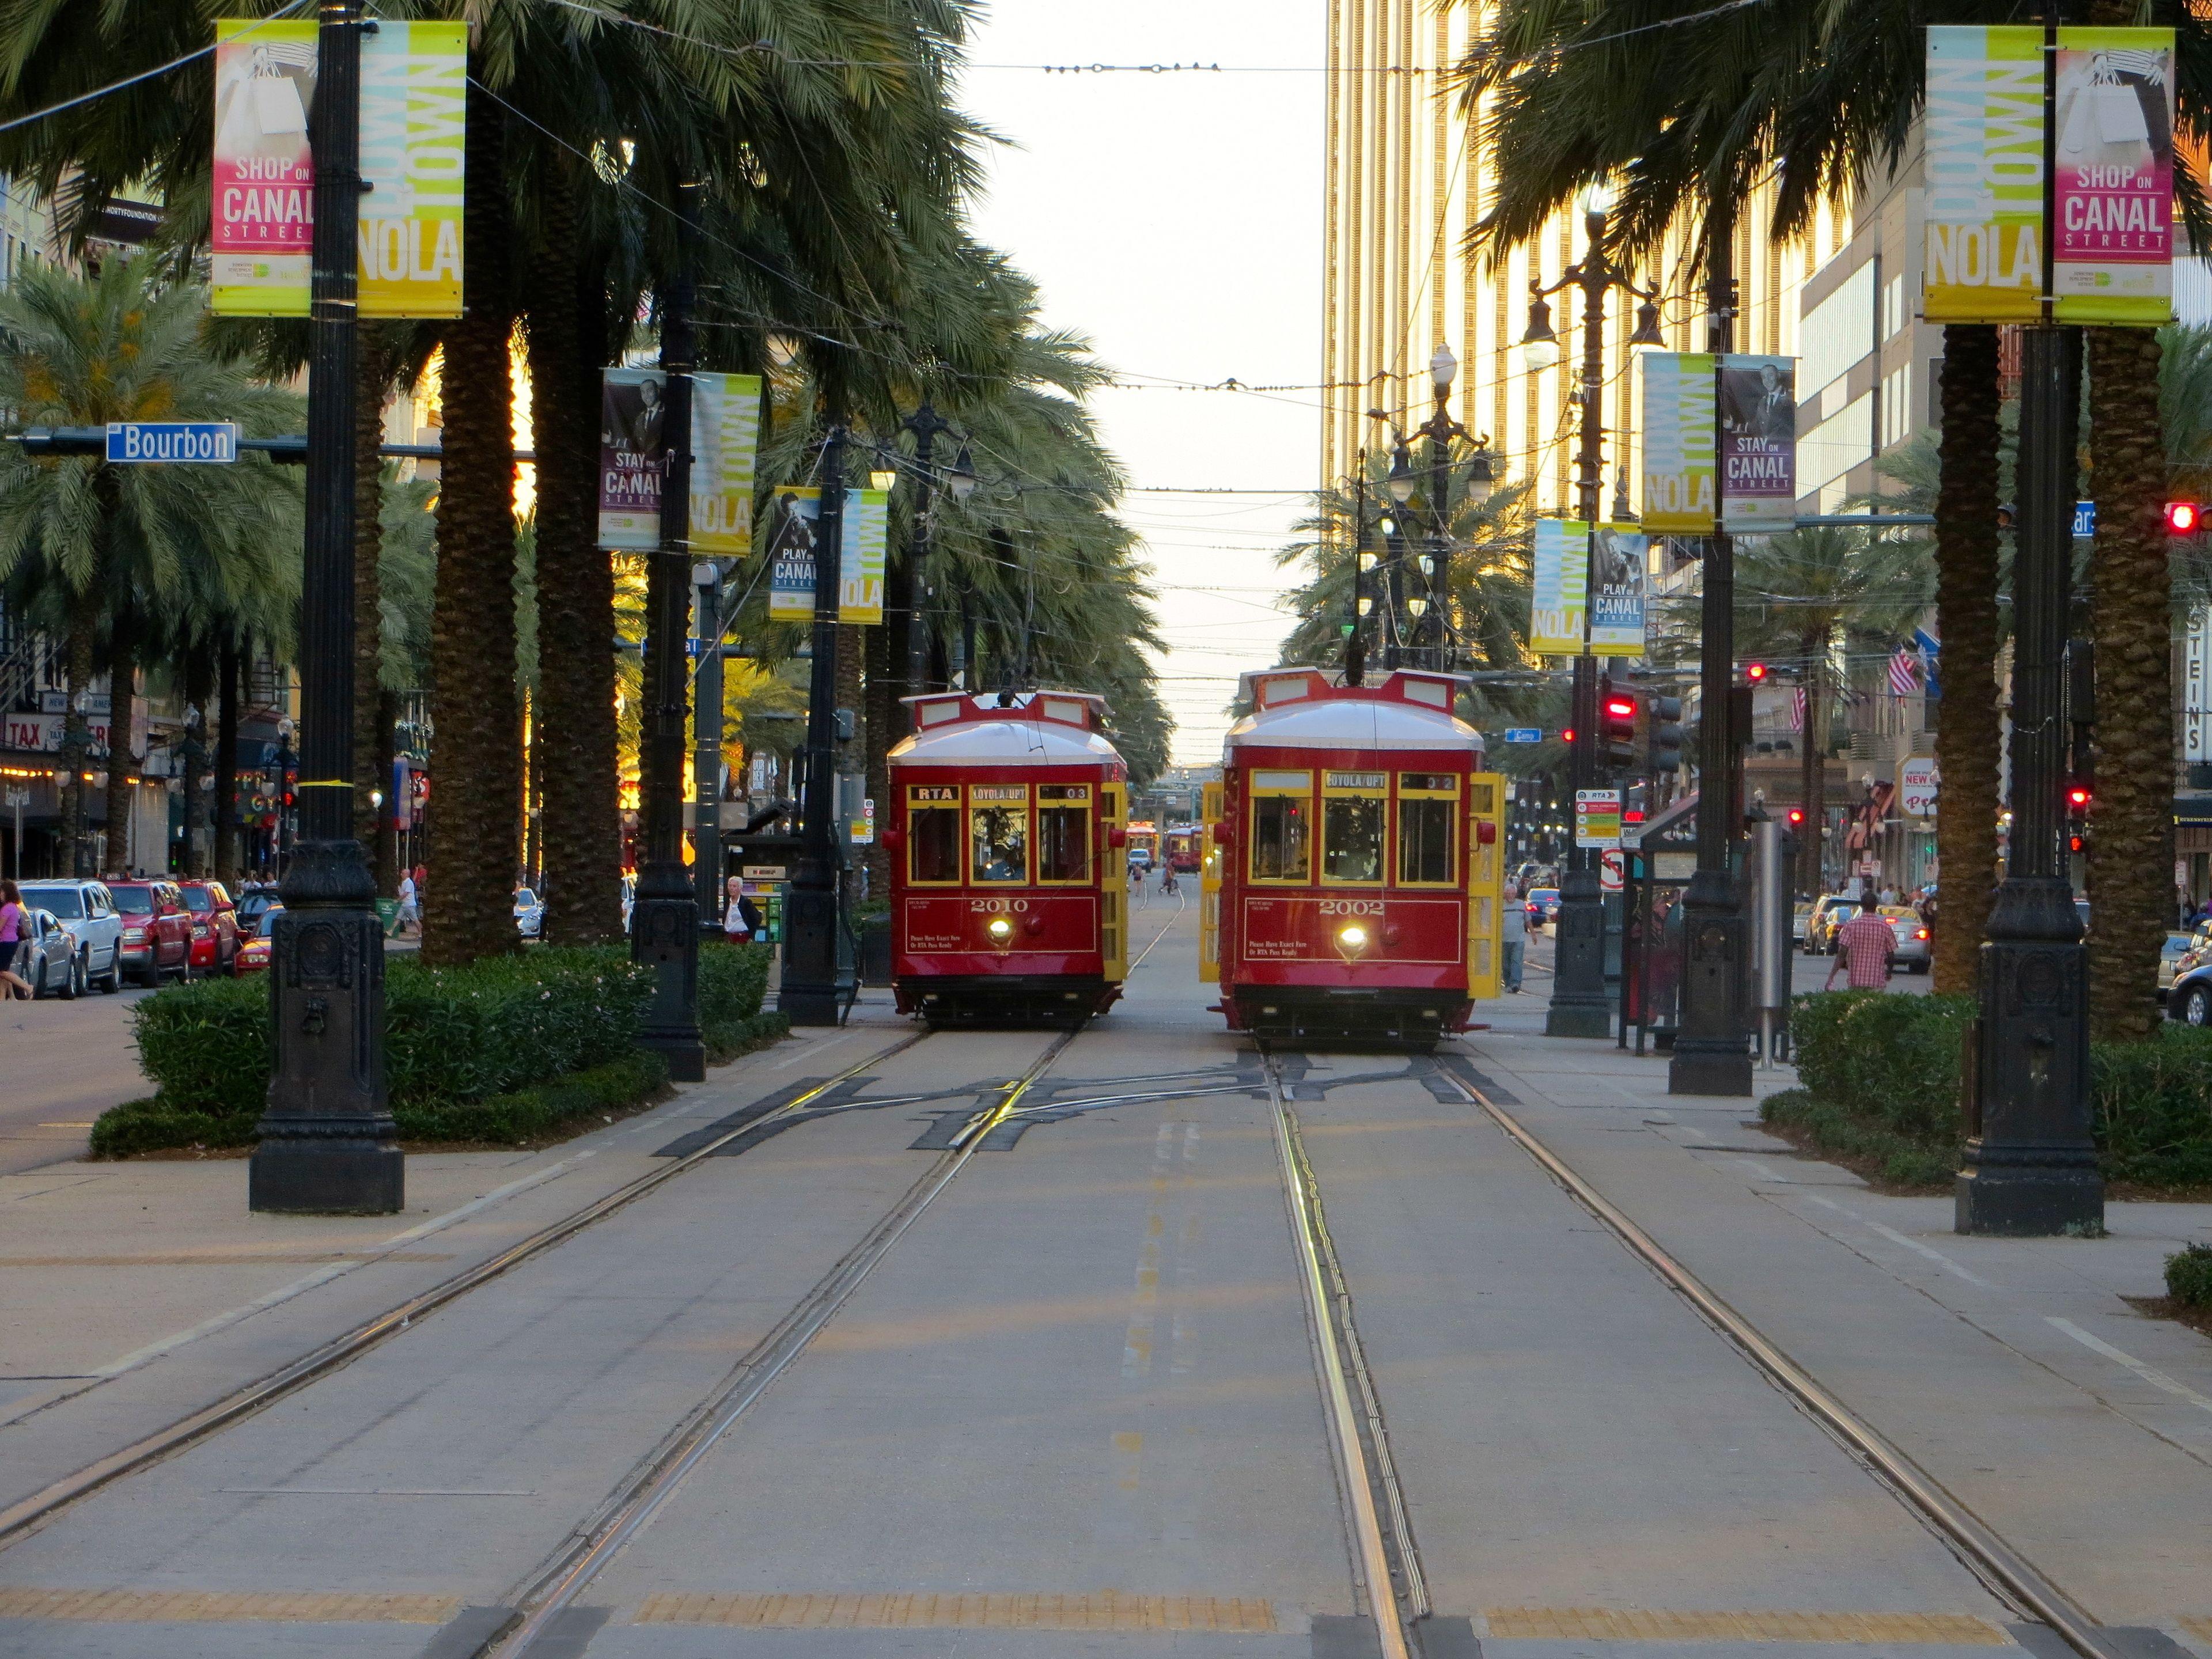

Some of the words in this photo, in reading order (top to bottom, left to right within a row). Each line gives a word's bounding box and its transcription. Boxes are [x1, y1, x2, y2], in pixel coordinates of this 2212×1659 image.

[406, 55, 467, 215] TOWN
[1926, 60, 1985, 221] DOWN
[1984, 60, 2044, 221] TOWN
[235, 157, 294, 180] SHOP
[296, 168, 309, 180] ON
[2077, 165, 2135, 188] SHOP
[2137, 177, 2152, 188] ON
[224, 188, 314, 224] CANAL
[2065, 196, 2164, 232] CANAL
[224, 225, 302, 238] STREE
[2065, 233, 2164, 247] STREET
[1927, 225, 2043, 287] NOLA
[1679, 373, 1715, 474] TOWN
[126, 426, 228, 459] Bourbon
[1737, 436, 1768, 452] STAY
[1768, 444, 1779, 452] ON
[616, 452, 646, 468] STAY
[1728, 457, 1789, 479] CANAL
[1728, 480, 1789, 488] STREET
[605, 495, 655, 504] STREE
[1645, 475, 1715, 513] NOLA
[782, 548, 807, 560] PLAY
[775, 579, 812, 587] STREE
[1603, 584, 1627, 595] PLAY
[1596, 598, 1640, 615] CANAL
[1533, 609, 1584, 639] NOLA
[10, 723, 40, 745] TAX
[1906, 775, 1927, 784] NEW
[918, 787, 953, 800] RTA
[971, 899, 1029, 912] 2010
[1319, 901, 1385, 915] 2002
